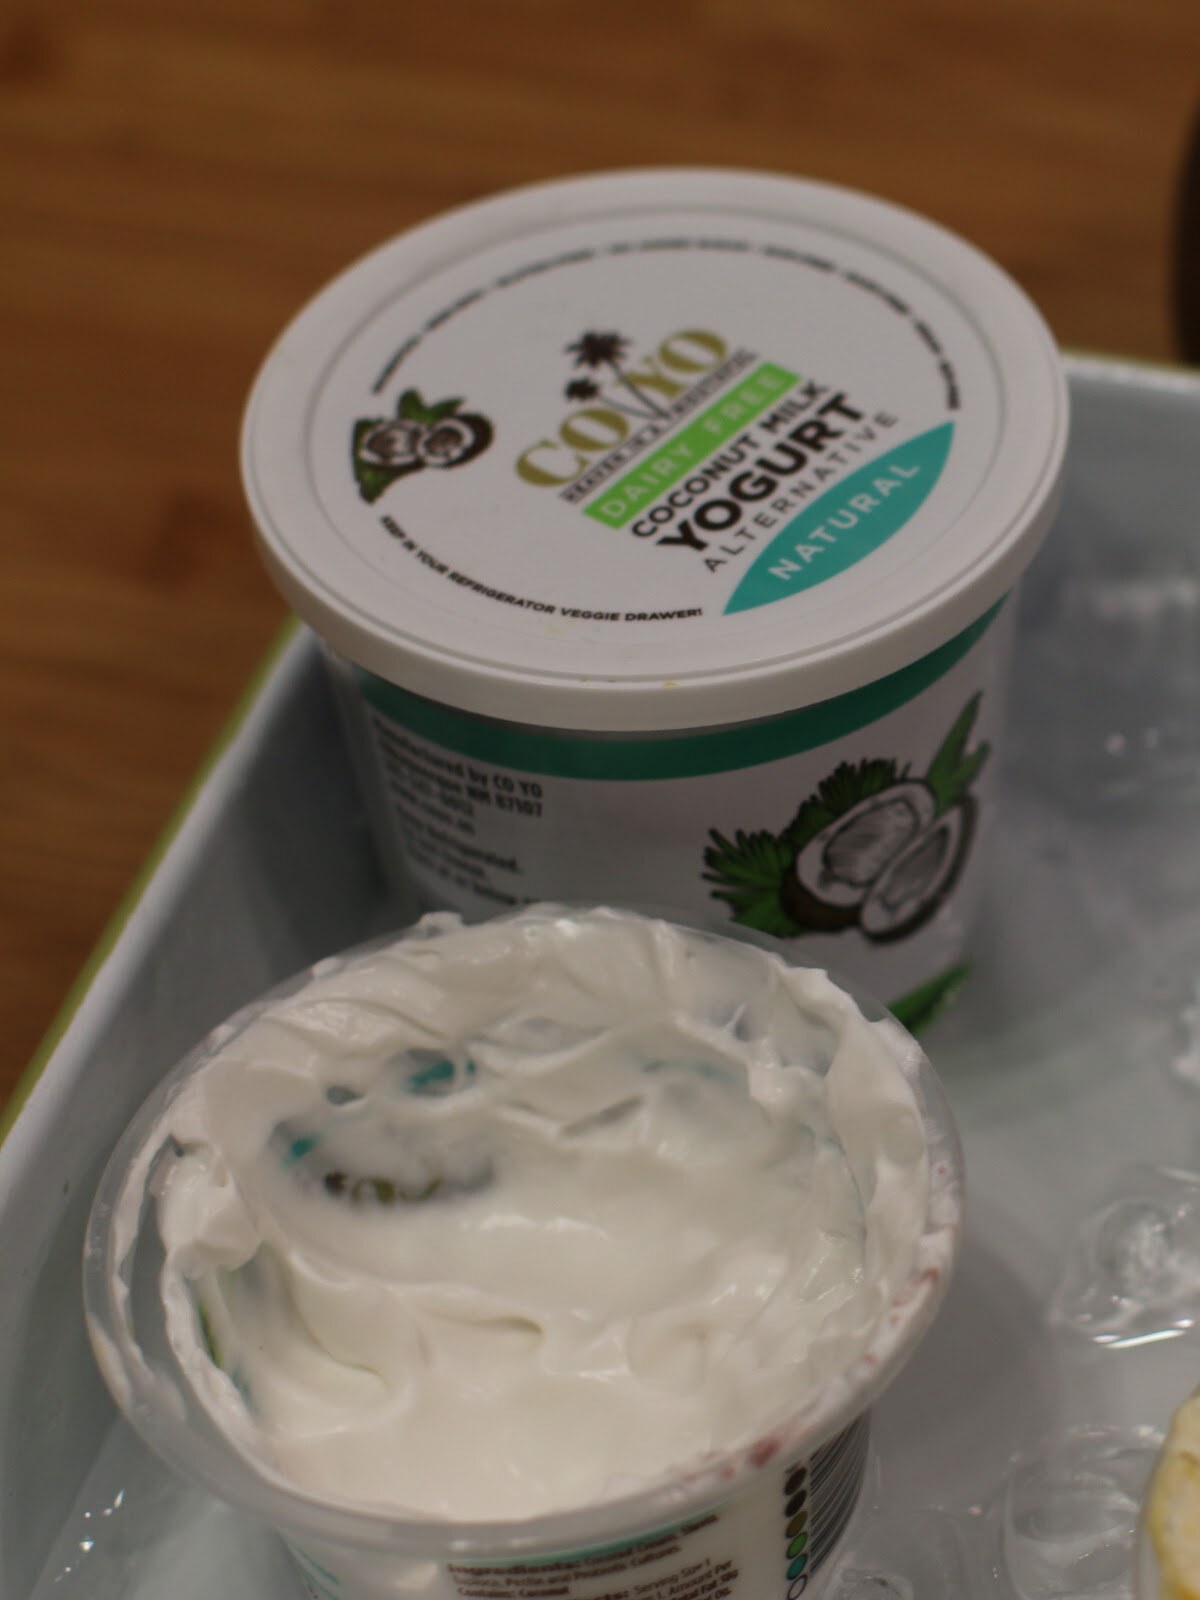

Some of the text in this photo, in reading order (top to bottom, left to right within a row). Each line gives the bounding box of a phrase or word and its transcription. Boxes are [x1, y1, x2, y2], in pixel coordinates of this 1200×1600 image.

[601, 372, 786, 519] DAIRY FREE
[631, 378, 832, 538] COCONUT MILK
[655, 391, 864, 552] YOGURT
[703, 411, 898, 572] ALTERNATIVE
[768, 462, 920, 581] NATURAL
[416, 549, 448, 575] YOUR
[448, 570, 556, 615] REFRIGERATOR
[561, 607, 620, 621] VEGGIE
[625, 607, 703, 622] DRAWER!
